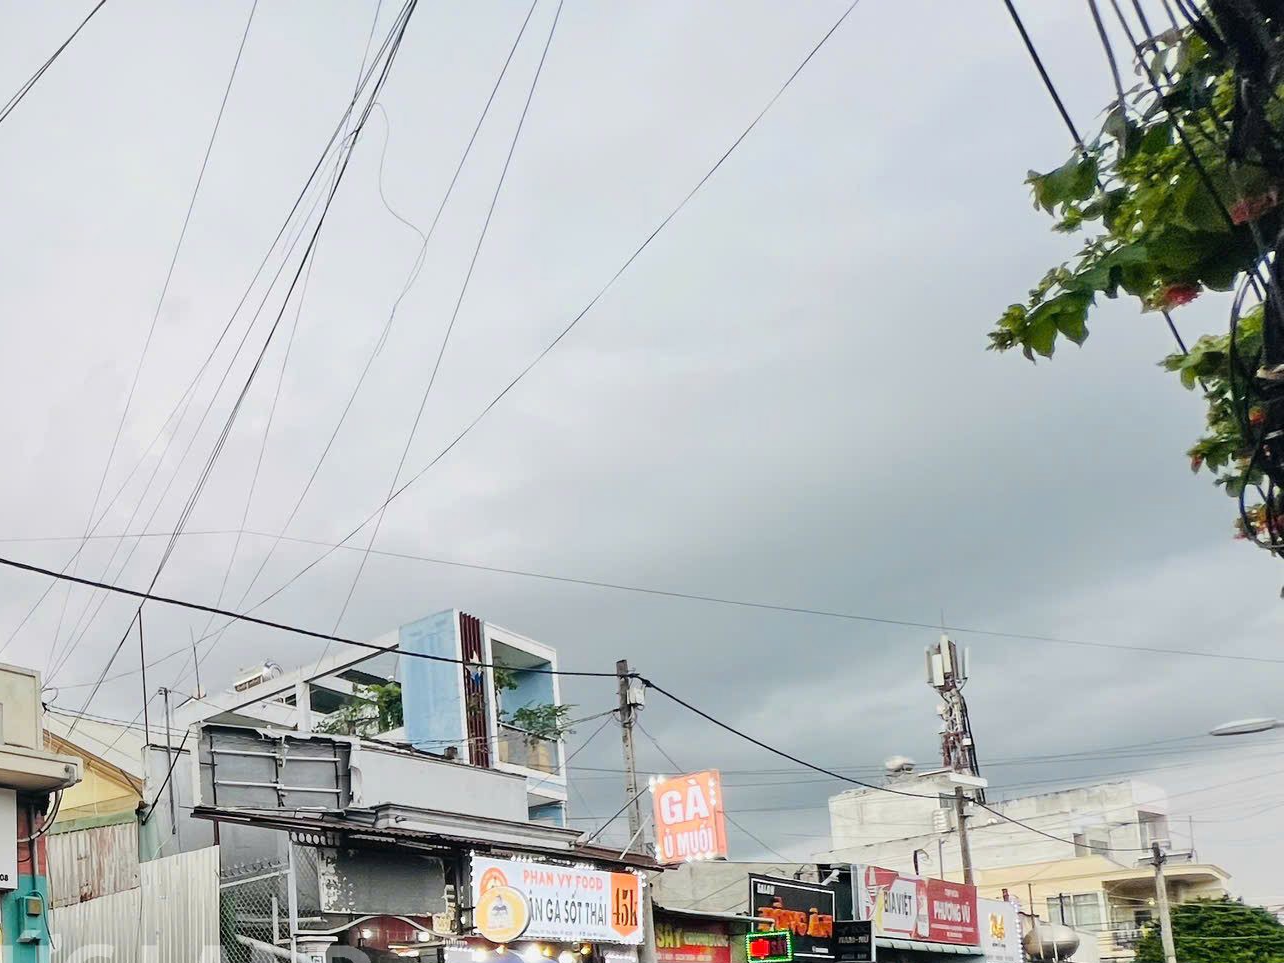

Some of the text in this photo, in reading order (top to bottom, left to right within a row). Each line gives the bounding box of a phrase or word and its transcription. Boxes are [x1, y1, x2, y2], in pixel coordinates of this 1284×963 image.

[659, 778, 710, 826] GÀ
[523, 869, 603, 891] PHAN VY FOOD
[546, 892, 561, 923] GÀ
[564, 889, 582, 925] SỐT
[585, 895, 607, 926] THÁI
